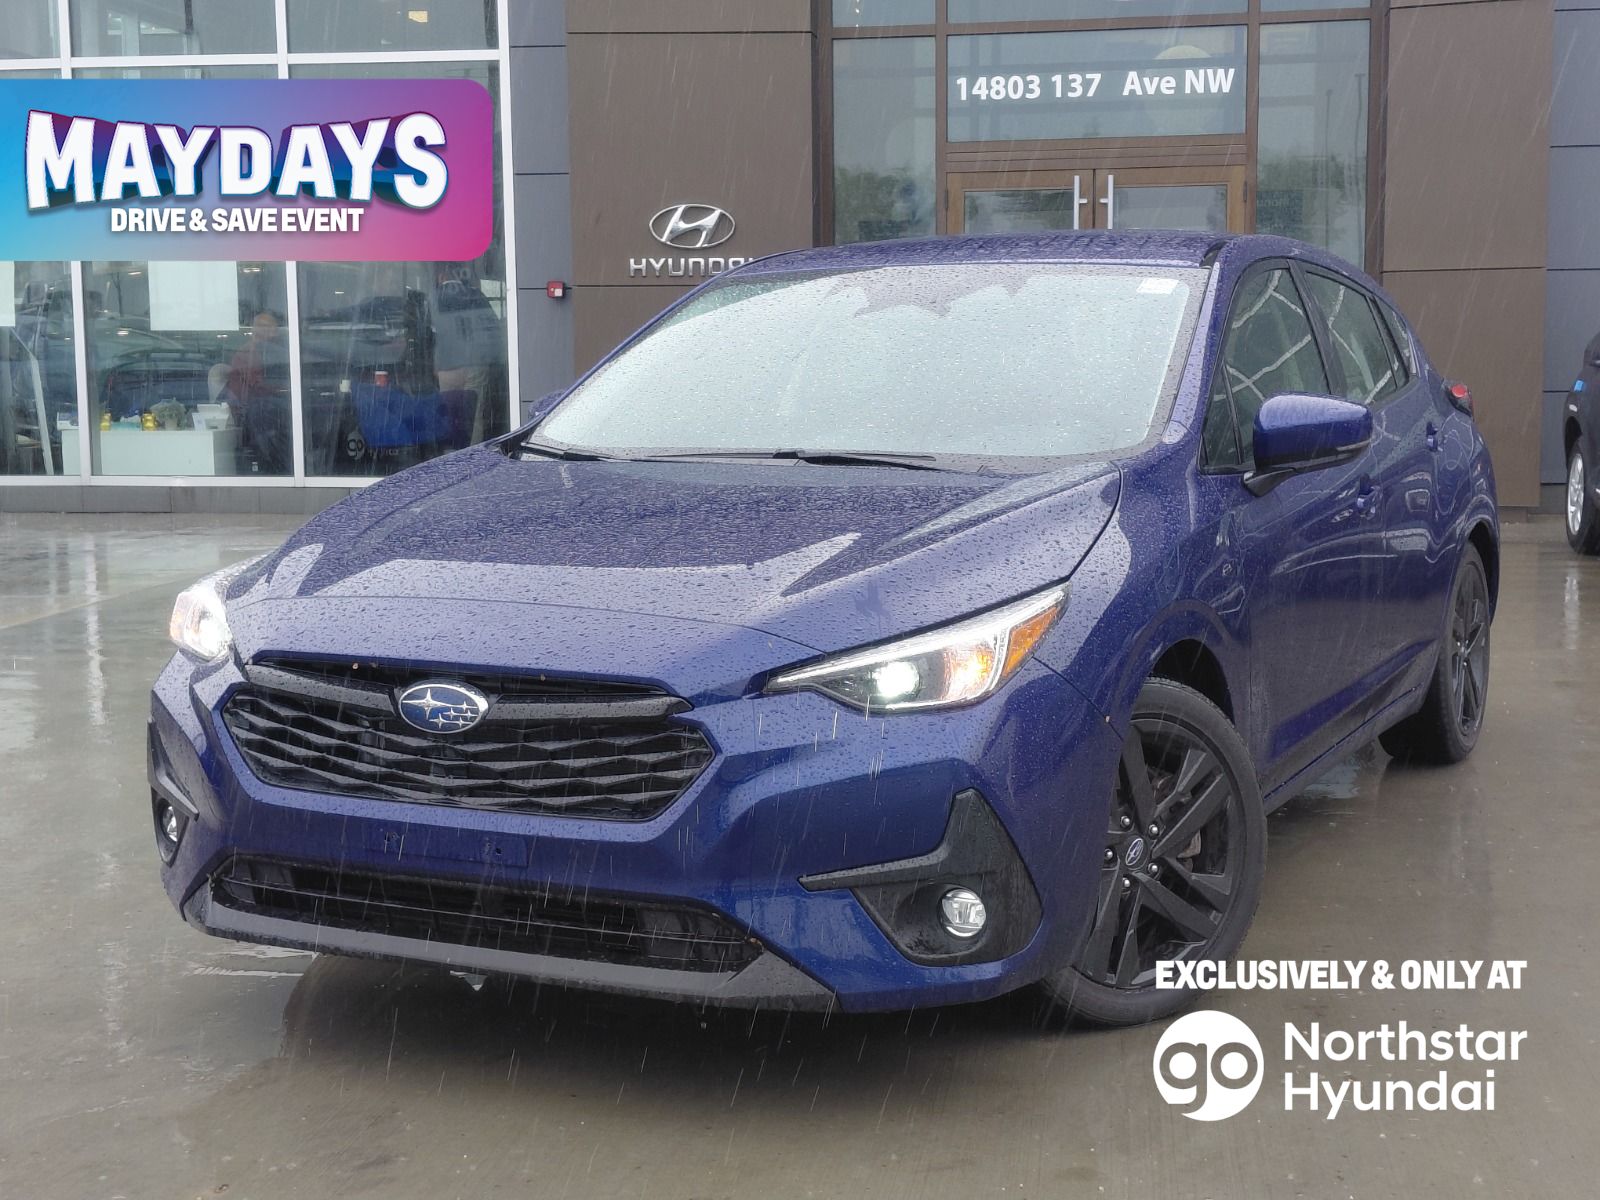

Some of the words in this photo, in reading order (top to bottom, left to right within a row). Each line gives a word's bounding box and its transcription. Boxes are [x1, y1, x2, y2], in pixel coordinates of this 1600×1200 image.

[956, 75, 1041, 101] 14803
[1051, 73, 1102, 98] 137
[1122, 71, 1177, 96] Ave
[1184, 68, 1235, 94] NW
[629, 257, 754, 277] HYUNDA
